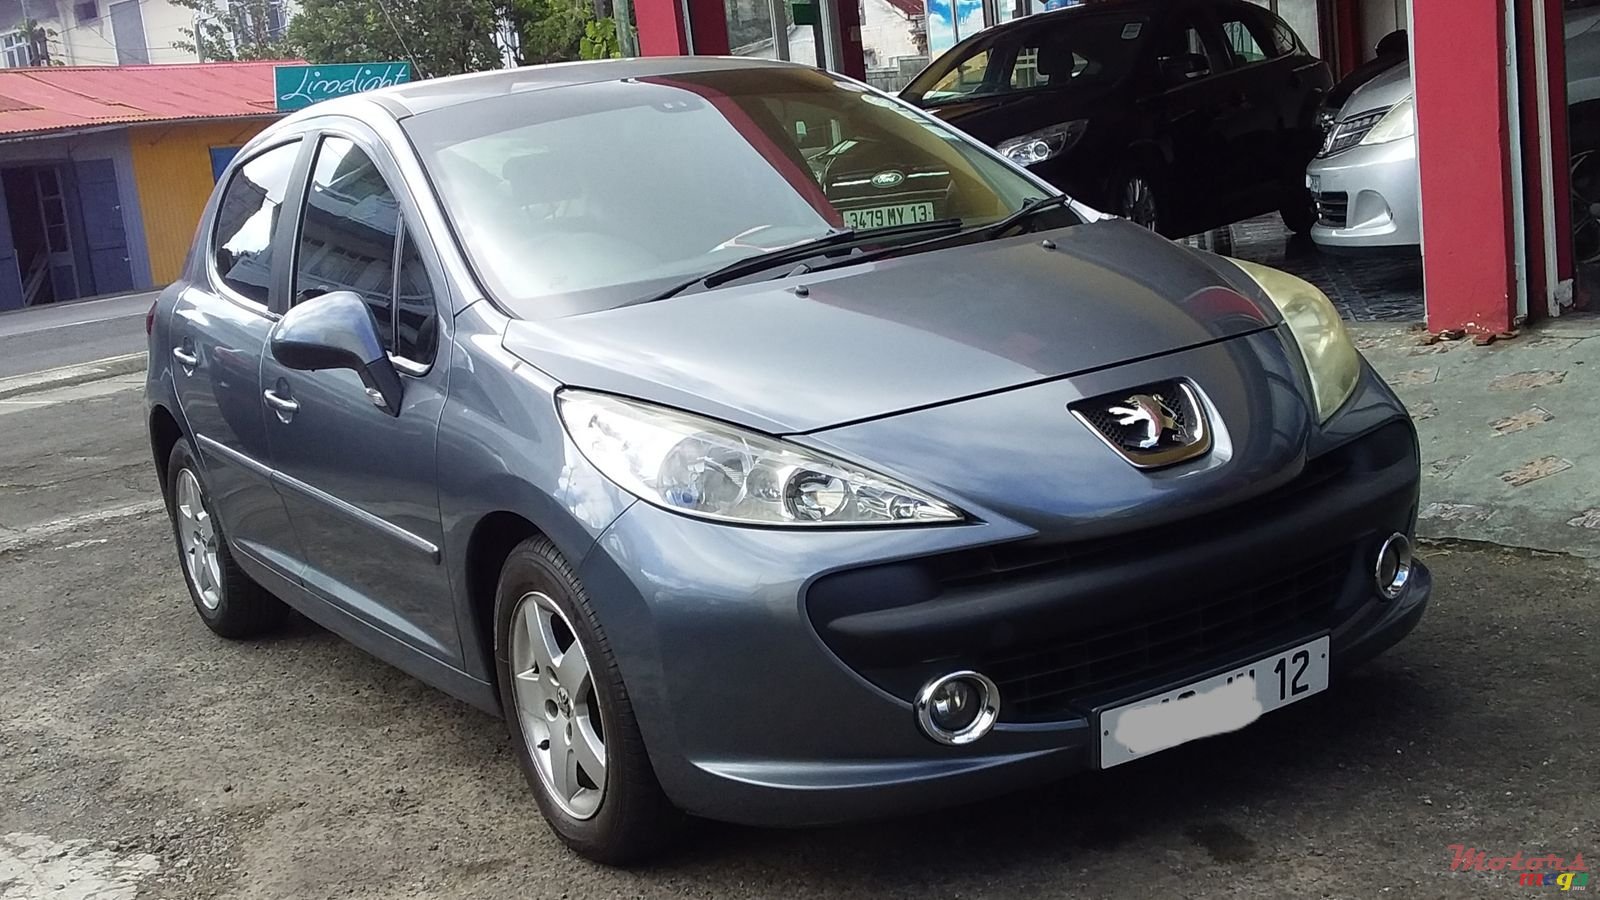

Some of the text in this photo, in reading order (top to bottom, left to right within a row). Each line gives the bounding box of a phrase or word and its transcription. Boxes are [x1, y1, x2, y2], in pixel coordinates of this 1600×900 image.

[281, 65, 406, 103] Limelight
[877, 173, 897, 184] Ford
[850, 205, 927, 229] 3479 MY 13
[1273, 649, 1310, 701] 12
